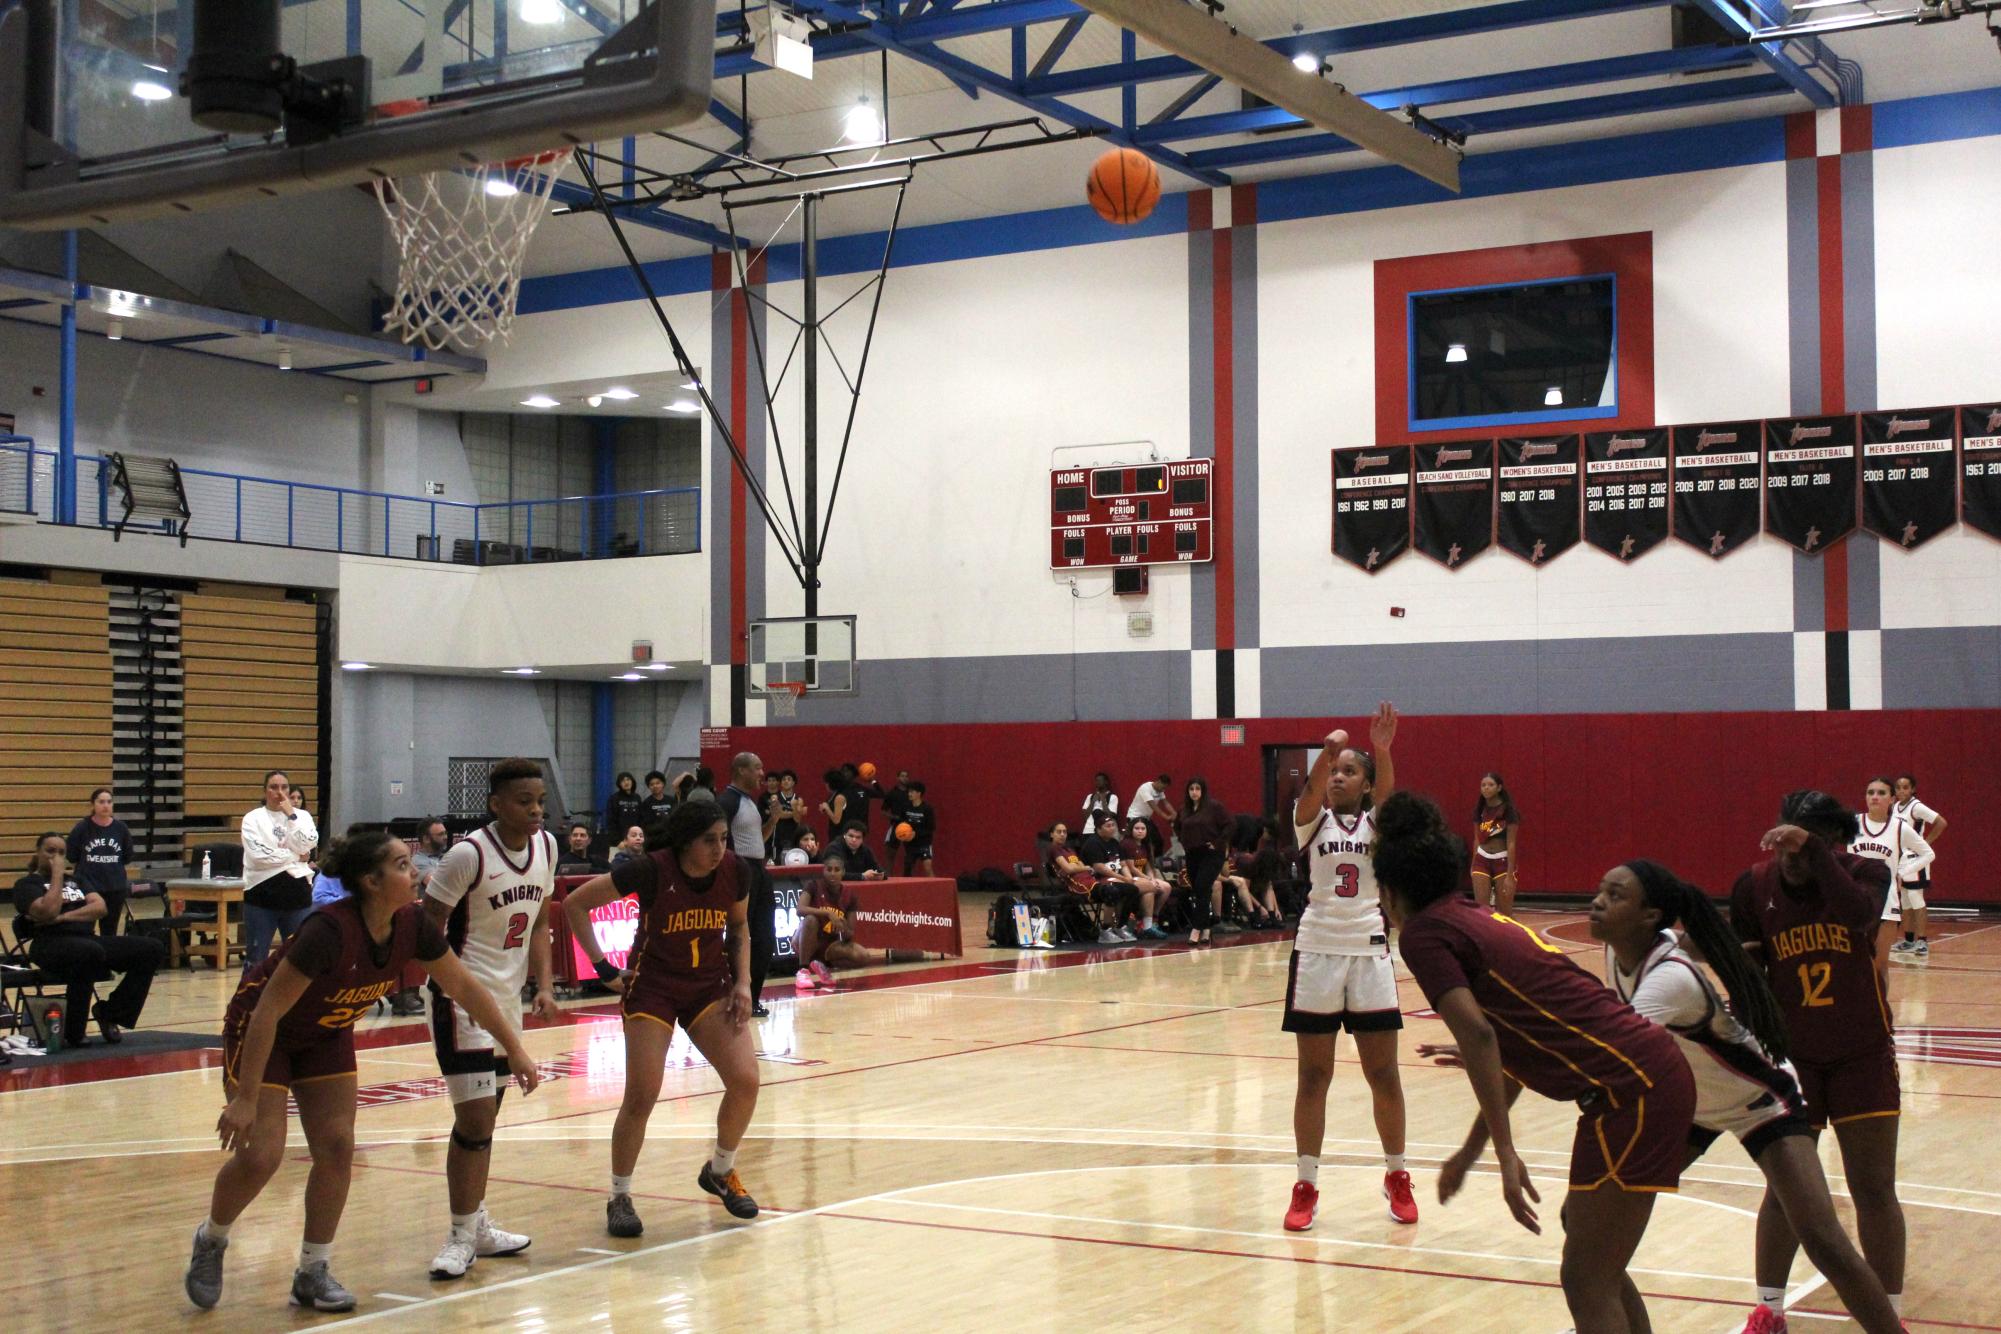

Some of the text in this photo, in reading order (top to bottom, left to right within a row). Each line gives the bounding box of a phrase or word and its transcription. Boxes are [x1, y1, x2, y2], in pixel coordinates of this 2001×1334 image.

[1868, 442, 1945, 455] MEN'S BASKETBALL
[1969, 438, 1994, 448] MEN'S
[1681, 454, 1752, 466] MEN'S BASKETBALL
[1774, 447, 1847, 460] MEN'S BASKETBALL
[1503, 465, 1574, 477] WOMEN'S BASKETBALL
[1591, 459, 1662, 471] MEN'S BASKETBALL
[1966, 464, 1984, 476] 1963
[1057, 463, 1209, 484] HOME VISITOR
[1418, 469, 1489, 482] BEACH SAND VOLLEYBALL
[1863, 467, 1929, 482] 2009 2017 2018
[1351, 476, 1393, 487] BASEBALL
[1675, 477, 1759, 493] 2009 2017 2018 2020
[1767, 473, 1831, 488] 2009 2017 2018
[1519, 490, 1535, 502] 2017
[1538, 489, 1555, 501] 2018
[1586, 482, 1667, 498] 2001 2005 2009 2012
[1109, 505, 1135, 515] PERIOD
[1337, 501, 1351, 513] 1961
[1353, 500, 1370, 511] 1962
[1372, 498, 1389, 510] 1990
[1588, 497, 1665, 512] 2014 2016 2017 2018
[1067, 513, 1091, 523] BONUS
[1169, 507, 1194, 517] BONUS
[1063, 529, 1086, 538] FOULS
[1106, 524, 1159, 536] PLAYER FOULS
[1174, 522, 1198, 532] FOULS
[1070, 558, 1085, 566] WON
[1119, 555, 1139, 563] GAME
[1178, 552, 1193, 561] WON
[84, 838, 122, 853] GAME DAY
[1317, 841, 1370, 857] KNIGHT
[1852, 842, 1893, 858] KNIGHTS
[86, 855, 119, 863] SWEATSHIRT
[1335, 863, 1359, 898] 3
[662, 908, 727, 934] JAGUARS
[856, 909, 952, 928] ww.sdcityknights.com
[503, 912, 529, 950] 2
[689, 936, 700, 968] 1
[1797, 962, 1834, 1007] 12
